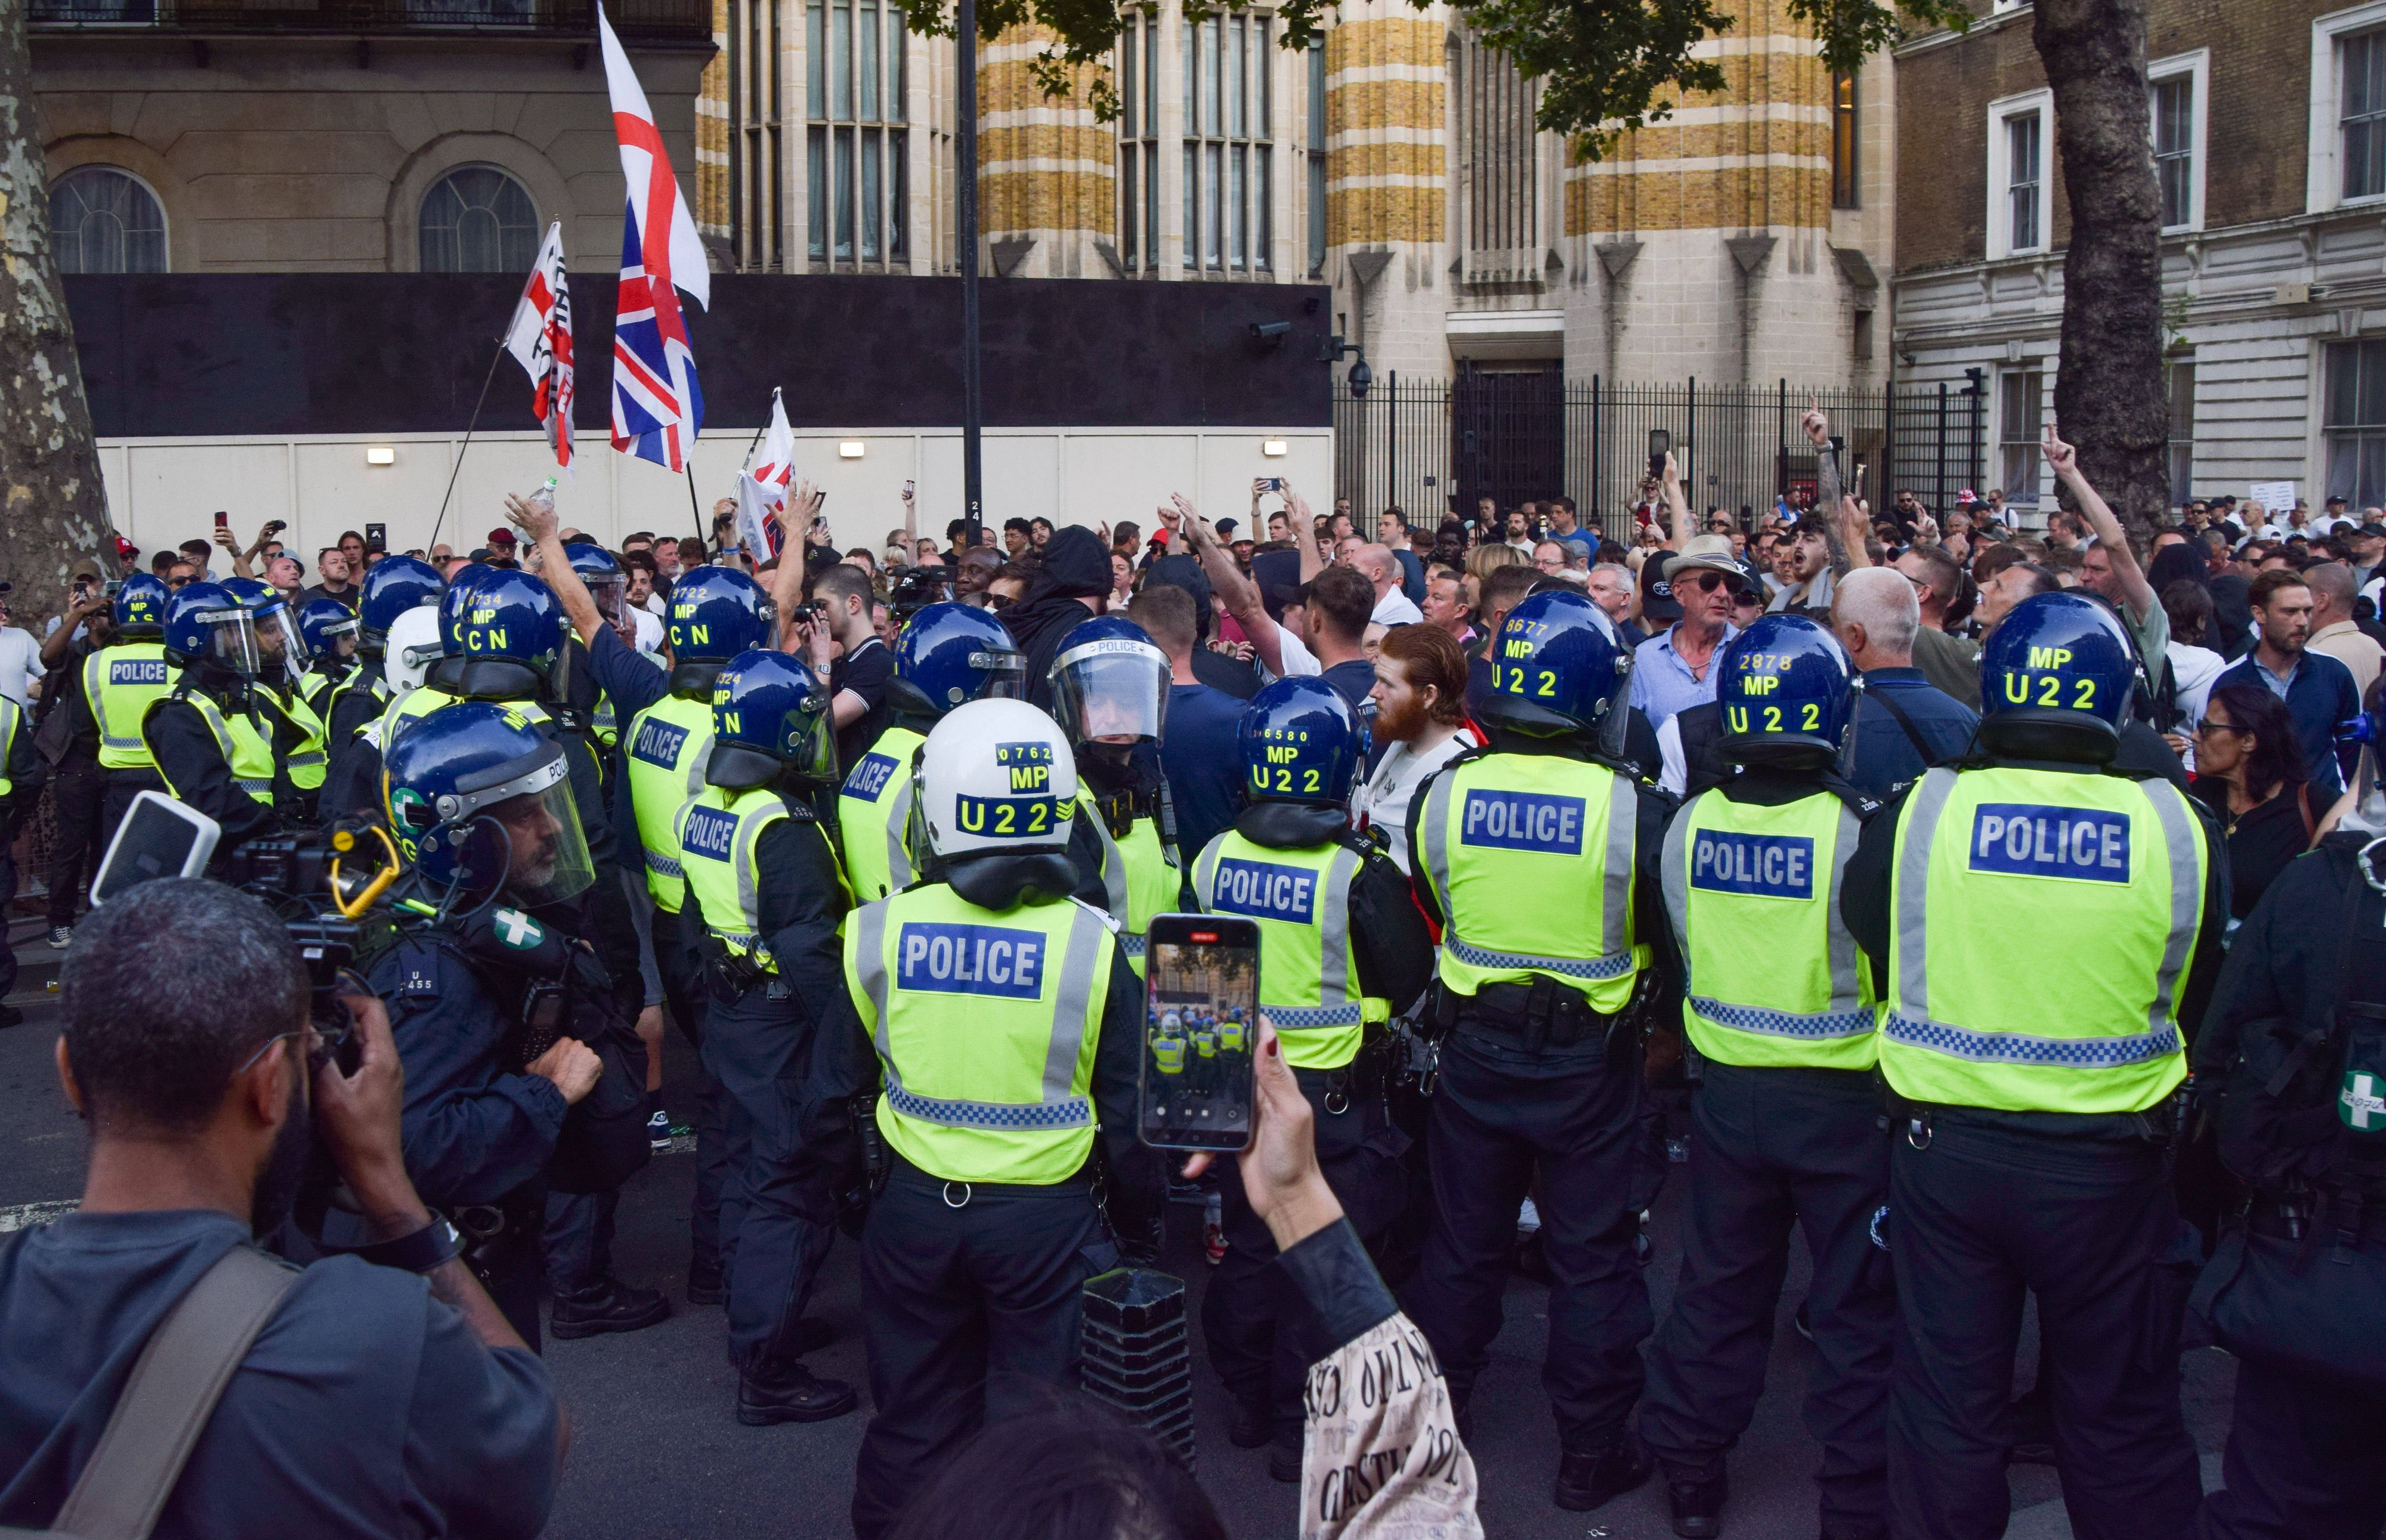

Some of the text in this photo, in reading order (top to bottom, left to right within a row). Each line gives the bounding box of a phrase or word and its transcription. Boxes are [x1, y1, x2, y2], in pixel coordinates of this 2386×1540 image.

[131, 602, 147, 611] MP
[468, 595, 501, 606] 0734
[473, 609, 496, 624] MP
[675, 604, 697, 619] MP
[1506, 619, 1549, 636] 8677
[1099, 642, 1137, 653] POLICE
[1505, 639, 1534, 659] MP
[1739, 653, 1791, 671] 2878
[2029, 646, 2072, 670] MP
[112, 663, 165, 681] POLICE
[1744, 676, 1779, 695] MP
[713, 689, 731, 705] MP
[636, 723, 683, 762] POLICE
[1265, 728, 1307, 741] 6580
[999, 747, 1052, 761] 0762
[1267, 746, 1298, 764] MP
[842, 760, 892, 794] OLICE
[1011, 765, 1049, 789] MP
[1467, 799, 1578, 843] POLICE
[684, 812, 734, 854] POLICE
[1978, 815, 2122, 868] POLICE
[1696, 840, 1806, 886] POLICE
[1217, 867, 1311, 914] POLICE
[905, 935, 1038, 986] POLICE
[412, 971, 419, 979] U
